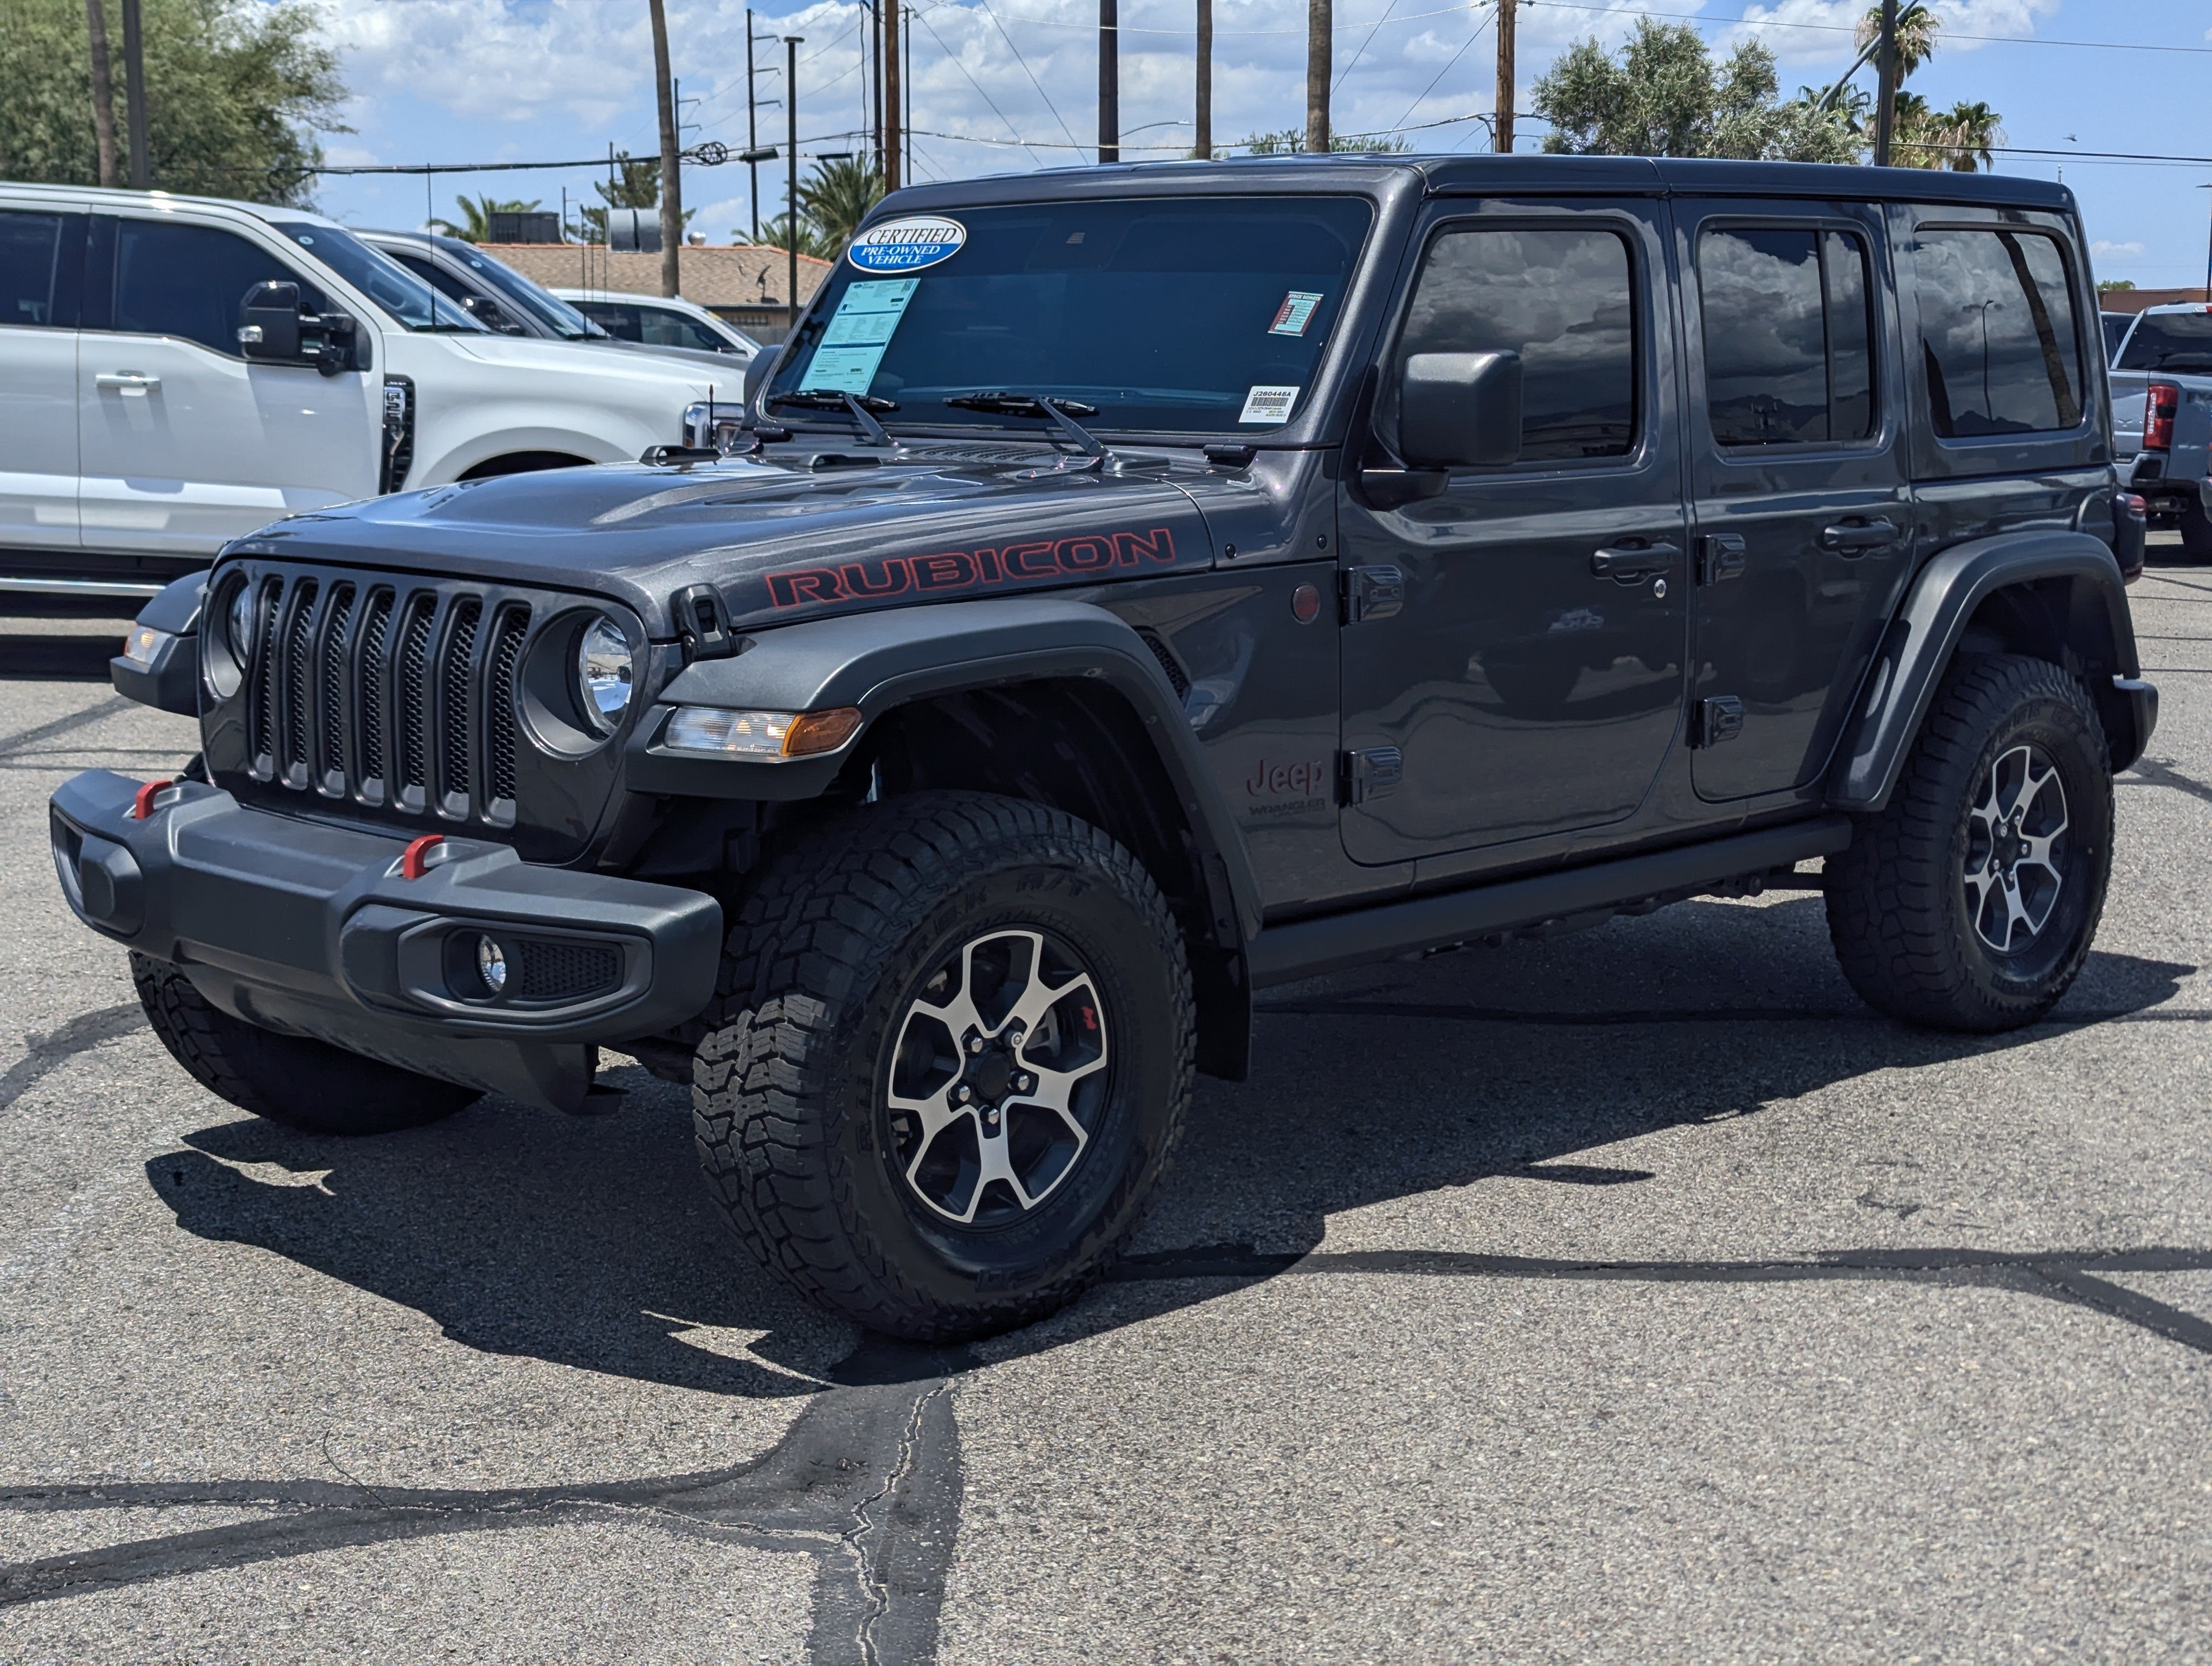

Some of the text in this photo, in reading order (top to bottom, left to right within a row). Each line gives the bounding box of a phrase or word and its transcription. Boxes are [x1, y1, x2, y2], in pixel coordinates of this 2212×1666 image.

[867, 227, 957, 245] CERTIFIED
[861, 245, 941, 257] PRE-OWNED
[867, 255, 923, 265] VEHICLE
[765, 528, 1176, 608] RUBICON
[1246, 759, 1323, 797] Jeep
[1015, 869, 1094, 898] A/T
